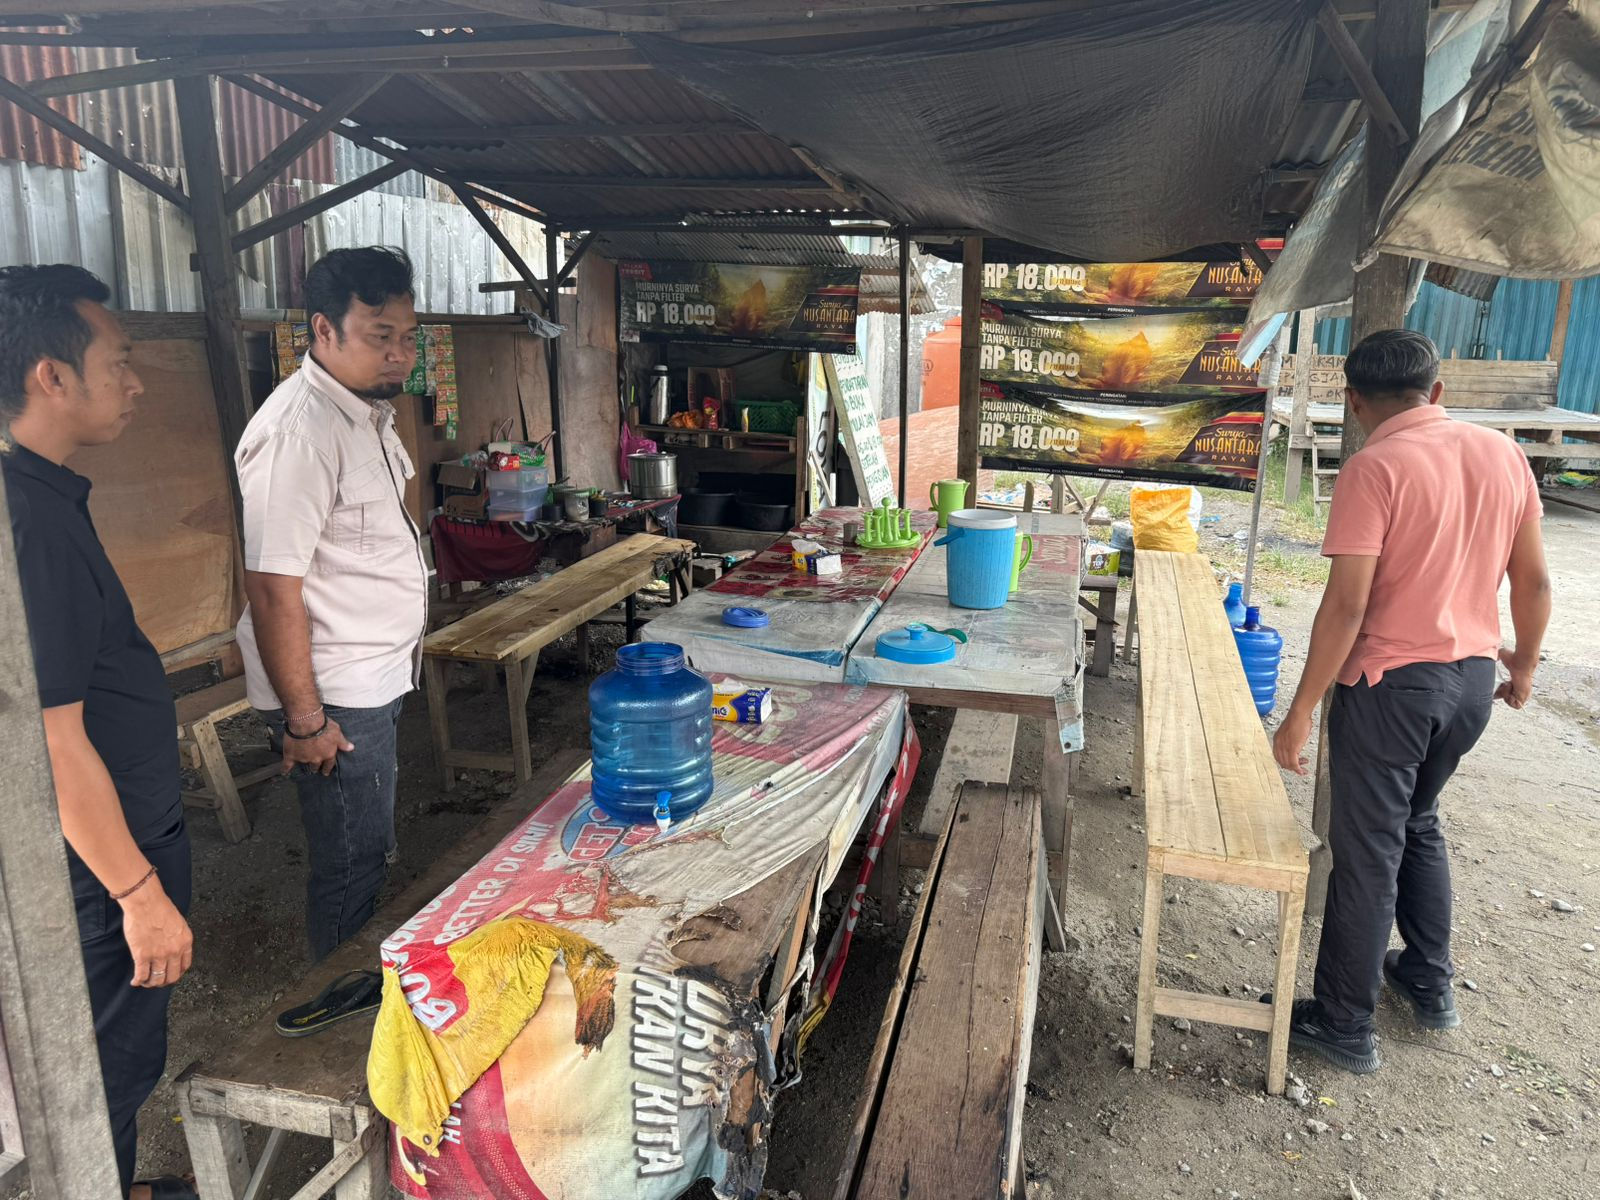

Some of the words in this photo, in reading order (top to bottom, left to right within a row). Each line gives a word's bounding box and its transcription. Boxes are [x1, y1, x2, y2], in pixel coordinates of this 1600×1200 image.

[984, 263, 1009, 288] RP
[635, 281, 674, 293] MURNINYA
[674, 283, 701, 294] SURYA
[636, 291, 661, 301] TANPA
[661, 292, 686, 302] FILTER
[635, 301, 657, 323] RP
[803, 307, 856, 323] NUSANTARA
[981, 322, 1029, 336] MURNINYA
[1031, 327, 1062, 339] SURYA
[982, 333, 1011, 346] TANPA
[1011, 336, 1042, 349] FILTER
[980, 345, 1006, 370] RP
[1215, 374, 1253, 382] RAYA
[982, 400, 1030, 413] MURNINYA
[982, 411, 1011, 422] TANPA
[1013, 412, 1043, 424] FILTER
[979, 422, 1005, 447] RP
[1214, 427, 1249, 441] Surya
[1211, 454, 1247, 463] RAYA
[568, 822, 625, 862] GET
[433, 878, 507, 946] BETTER
[493, 855, 522, 874] DI
[514, 820, 554, 855] SINI!
[635, 1080, 685, 1175] KITA
